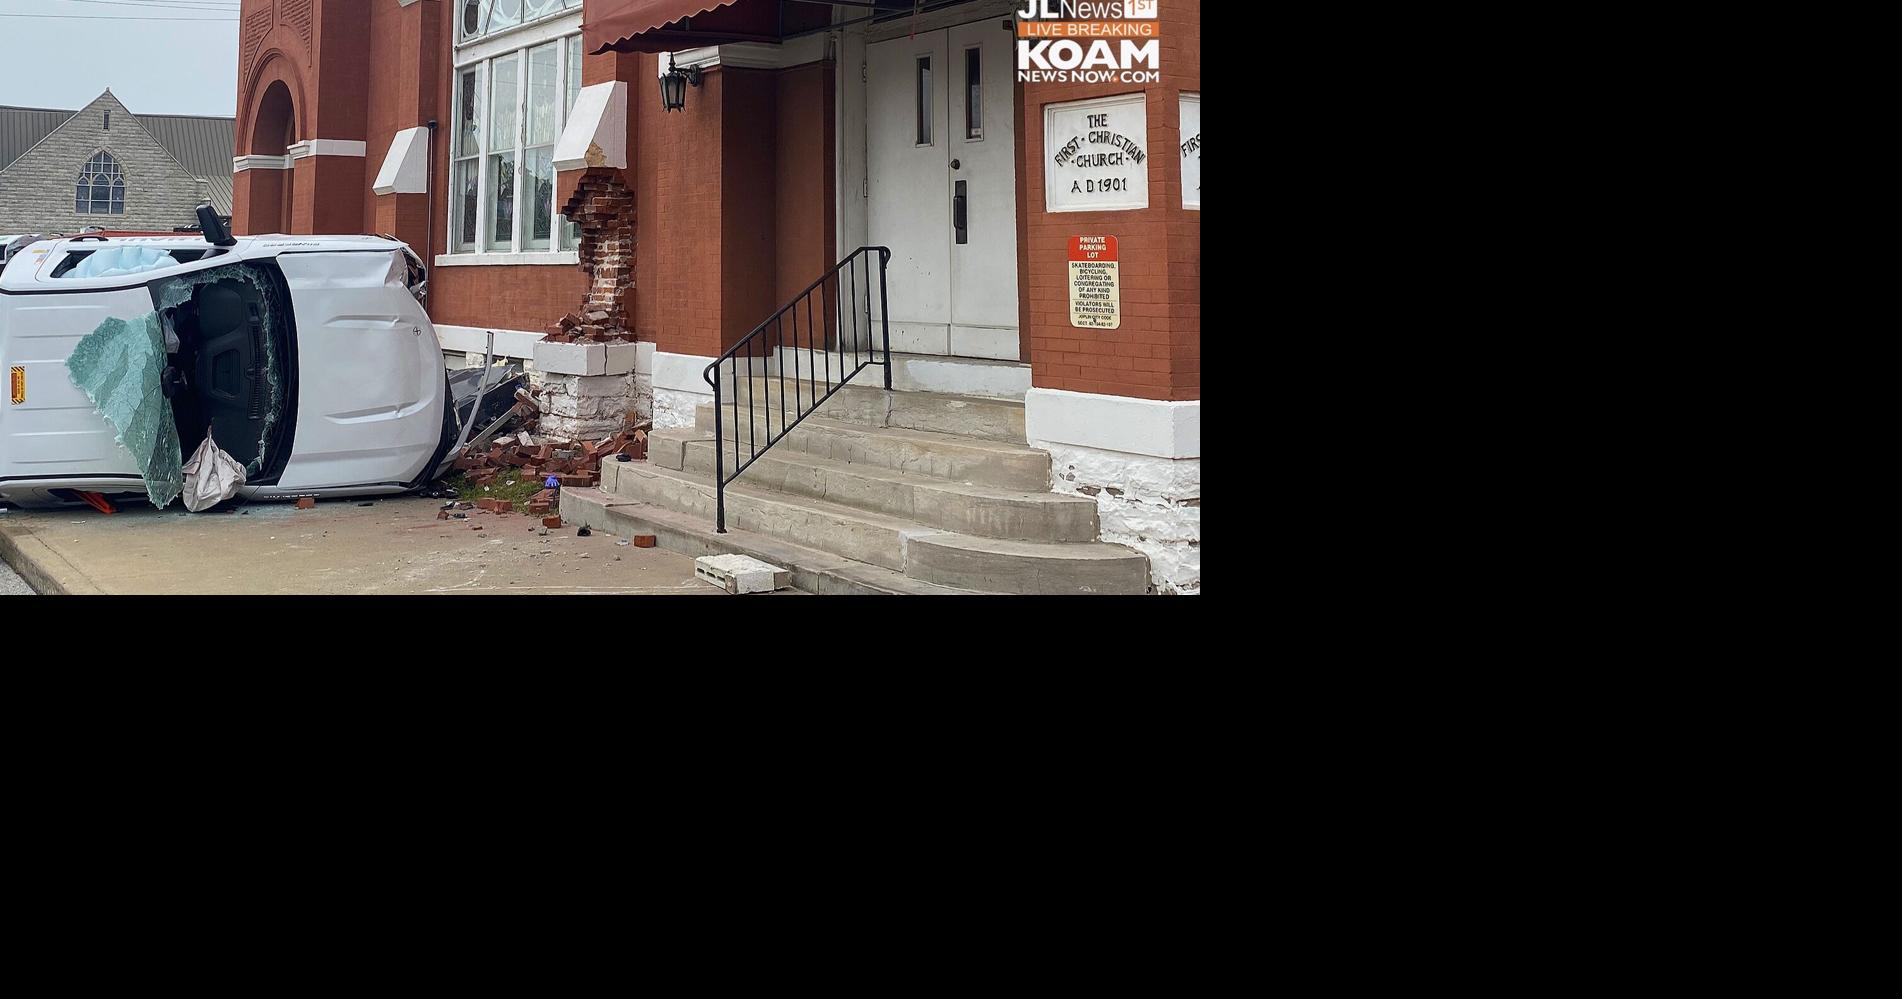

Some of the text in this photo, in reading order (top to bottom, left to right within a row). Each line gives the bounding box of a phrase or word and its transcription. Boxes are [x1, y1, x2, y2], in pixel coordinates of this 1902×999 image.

[1087, 113, 1108, 128] THE
[1054, 130, 1146, 168] FIRST CHRISTIAN
[1076, 152, 1124, 168] CHURCH
[1071, 177, 1128, 193] A D 1901
